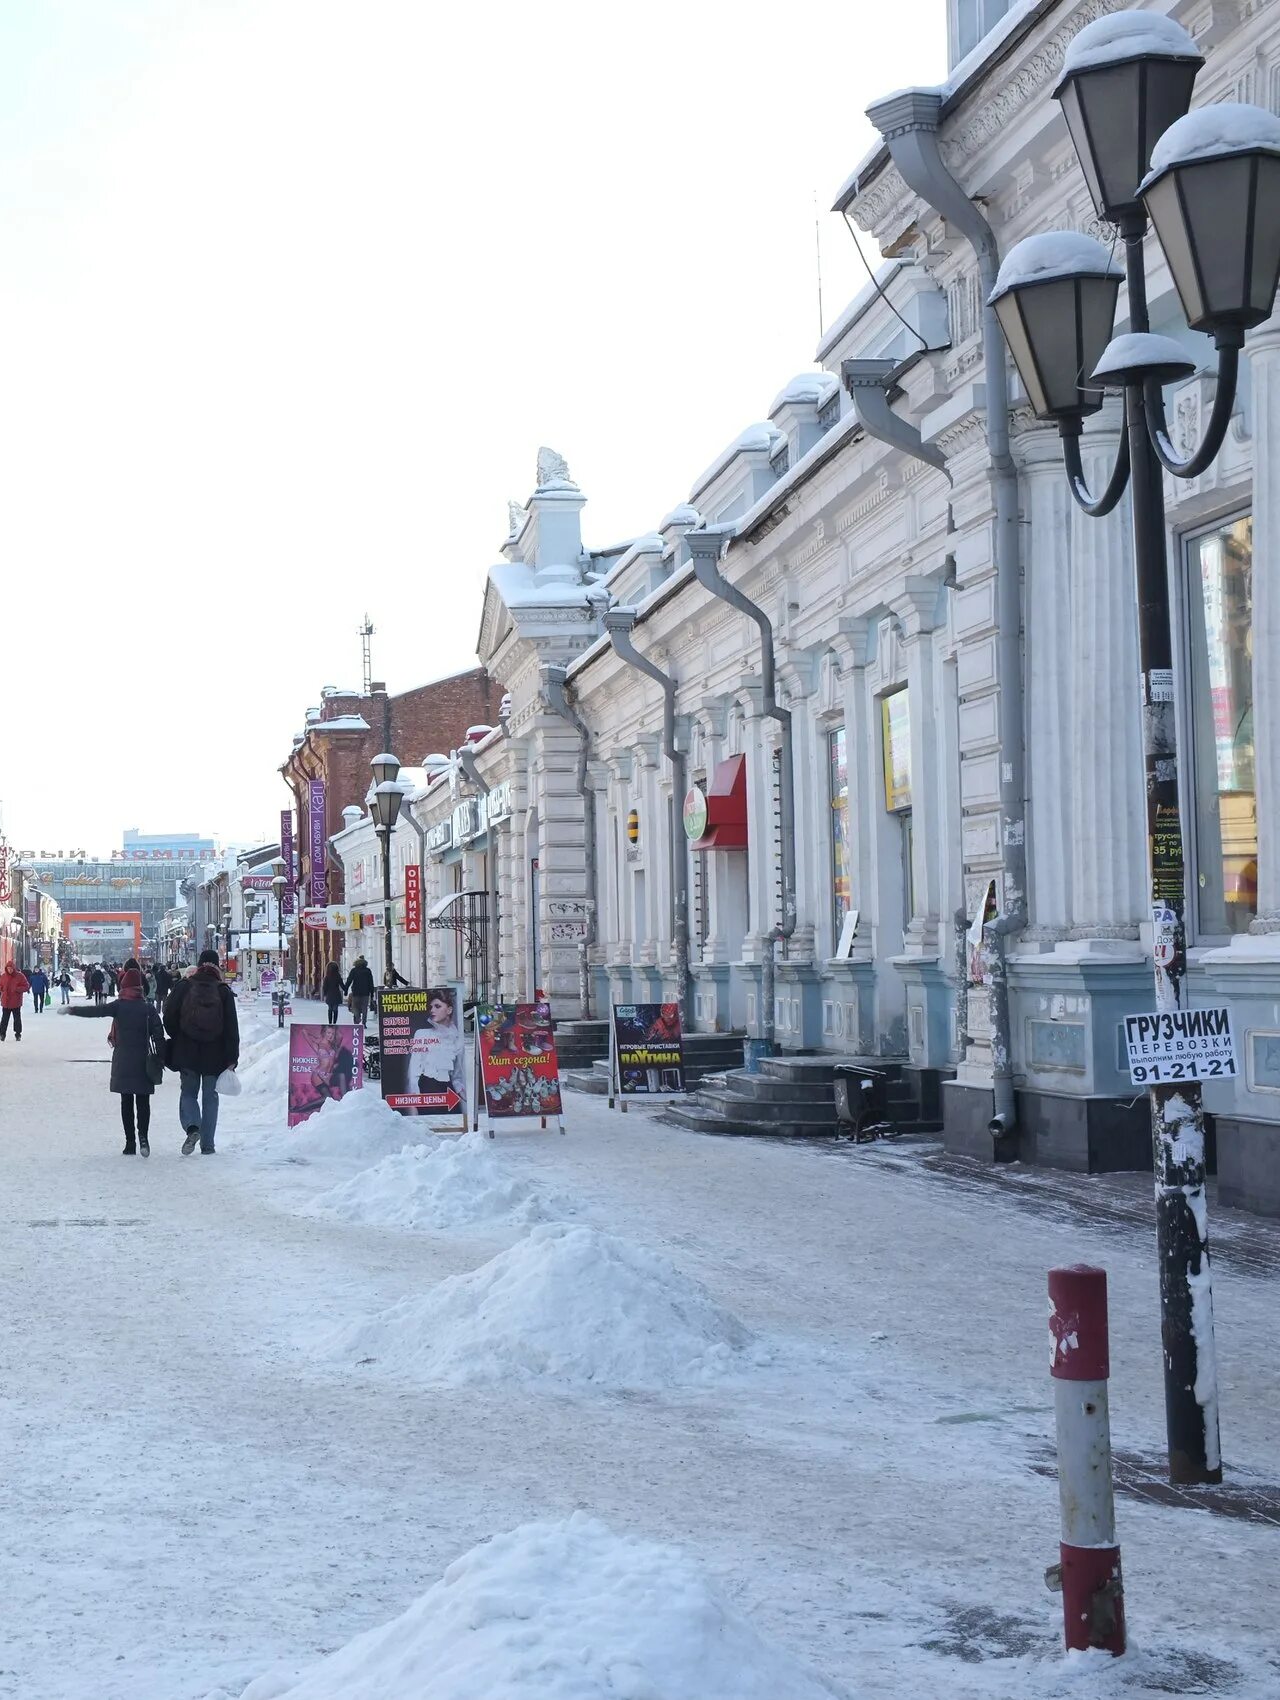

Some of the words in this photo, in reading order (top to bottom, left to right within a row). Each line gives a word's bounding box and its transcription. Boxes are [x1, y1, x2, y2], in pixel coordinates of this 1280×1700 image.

[312, 786, 324, 814] kari
[282, 814, 292, 838] kari
[314, 846, 322, 864] ДОМ
[1153, 846, 1166, 855] 35
[312, 872, 326, 899] kari
[283, 886, 294, 910] kari
[408, 869, 417, 930] ОПТИКА
[381, 992, 428, 1004] ЖЕНСКИЙ
[382, 1003, 427, 1013] ТРИКОТАЖ
[1125, 1008, 1230, 1043] ГРУЗЧИКИ
[1129, 1037, 1232, 1055] ПЕРЕВОЗКИ
[488, 1055, 511, 1066] Хит
[513, 1053, 550, 1068] сезона!
[1131, 1055, 1173, 1064] выполним
[1174, 1052, 1203, 1060] любую
[1205, 1049, 1233, 1059] работу
[1133, 1058, 1237, 1082] 91-21-21
[395, 1096, 422, 1104] НИЗКИЕ
